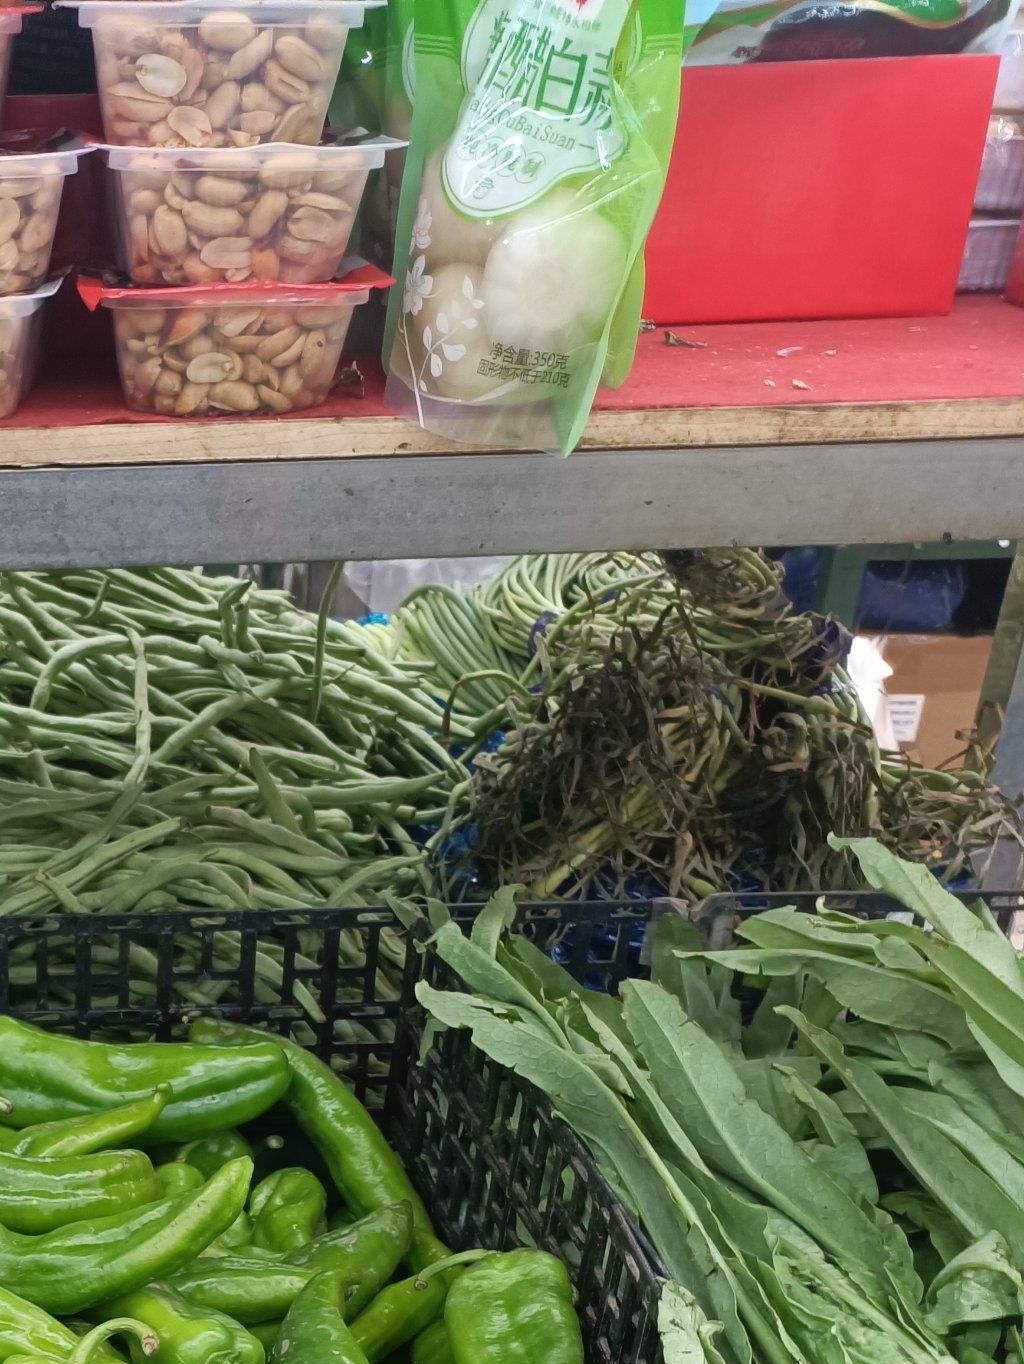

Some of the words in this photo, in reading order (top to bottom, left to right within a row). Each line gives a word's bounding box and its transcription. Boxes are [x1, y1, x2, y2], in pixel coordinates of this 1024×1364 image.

[469, 99, 576, 152] angCuBaiSuan
[489, 341, 570, 370] 净含量:350克
[477, 358, 571, 388] 固形物不低于210克
